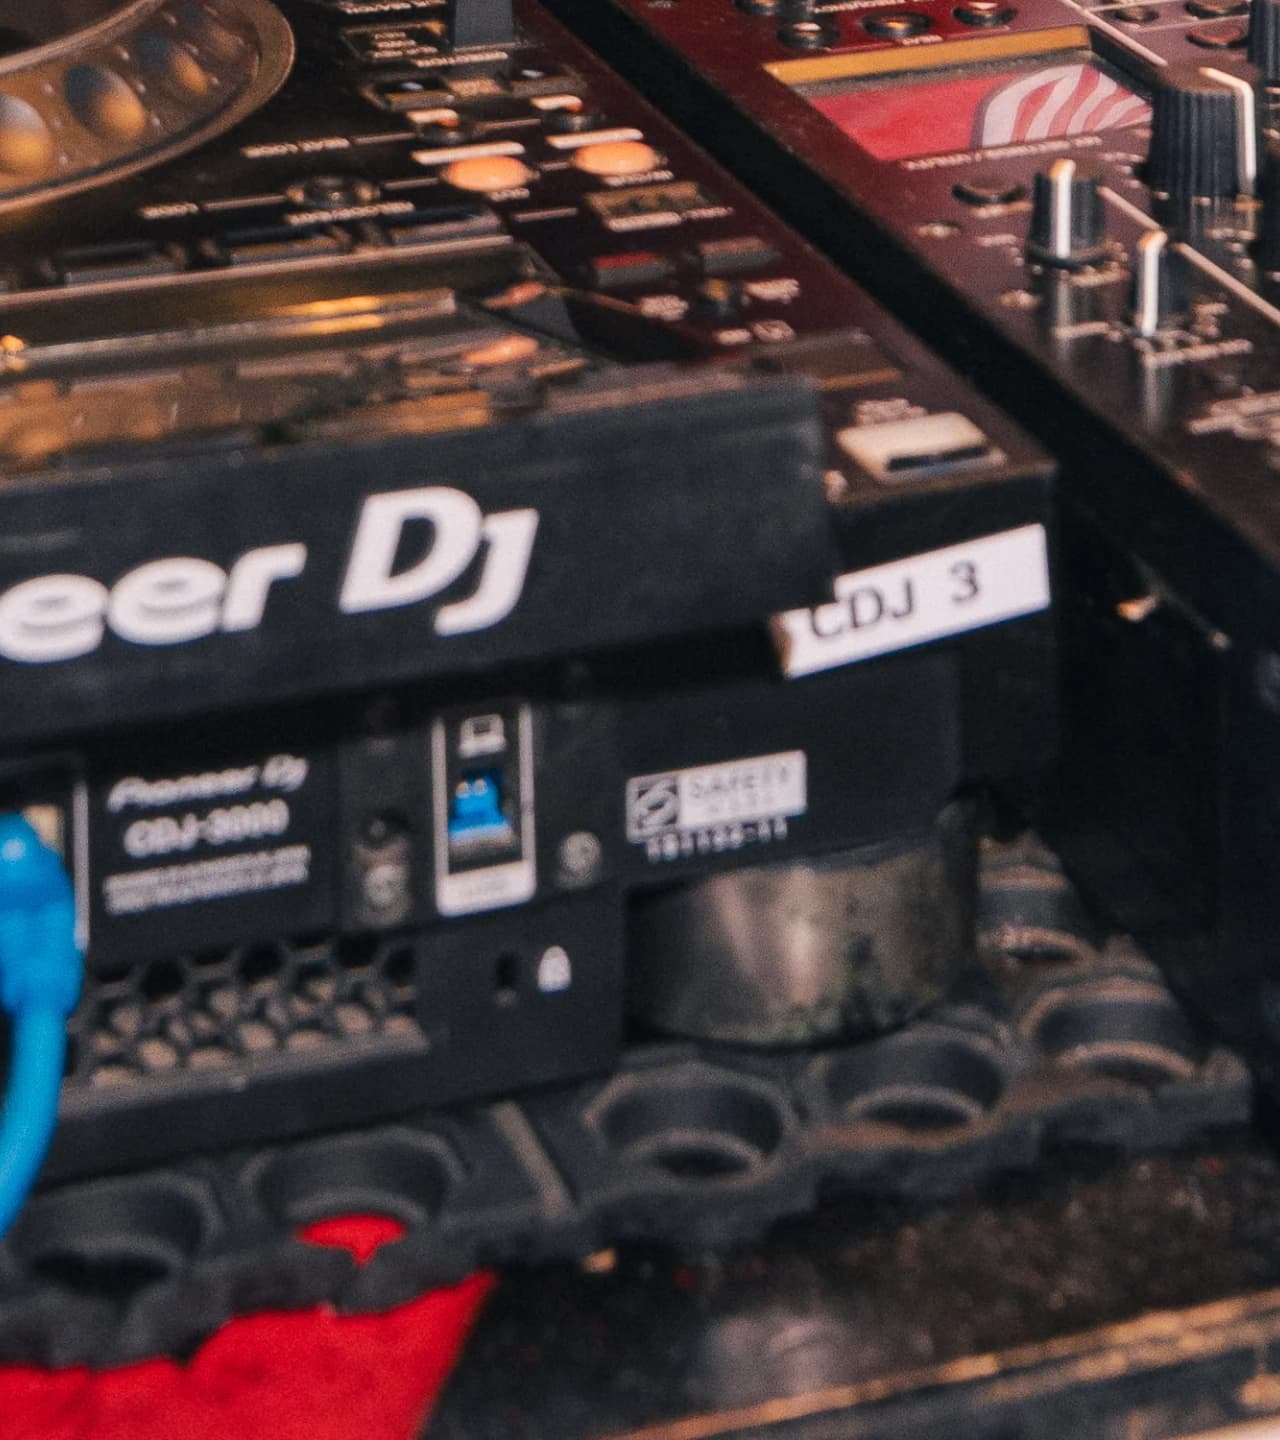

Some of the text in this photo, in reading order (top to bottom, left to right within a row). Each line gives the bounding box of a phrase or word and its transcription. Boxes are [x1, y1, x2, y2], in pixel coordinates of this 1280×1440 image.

[806, 560, 984, 646] CDJ 3
[107, 759, 267, 812] Pioneer
